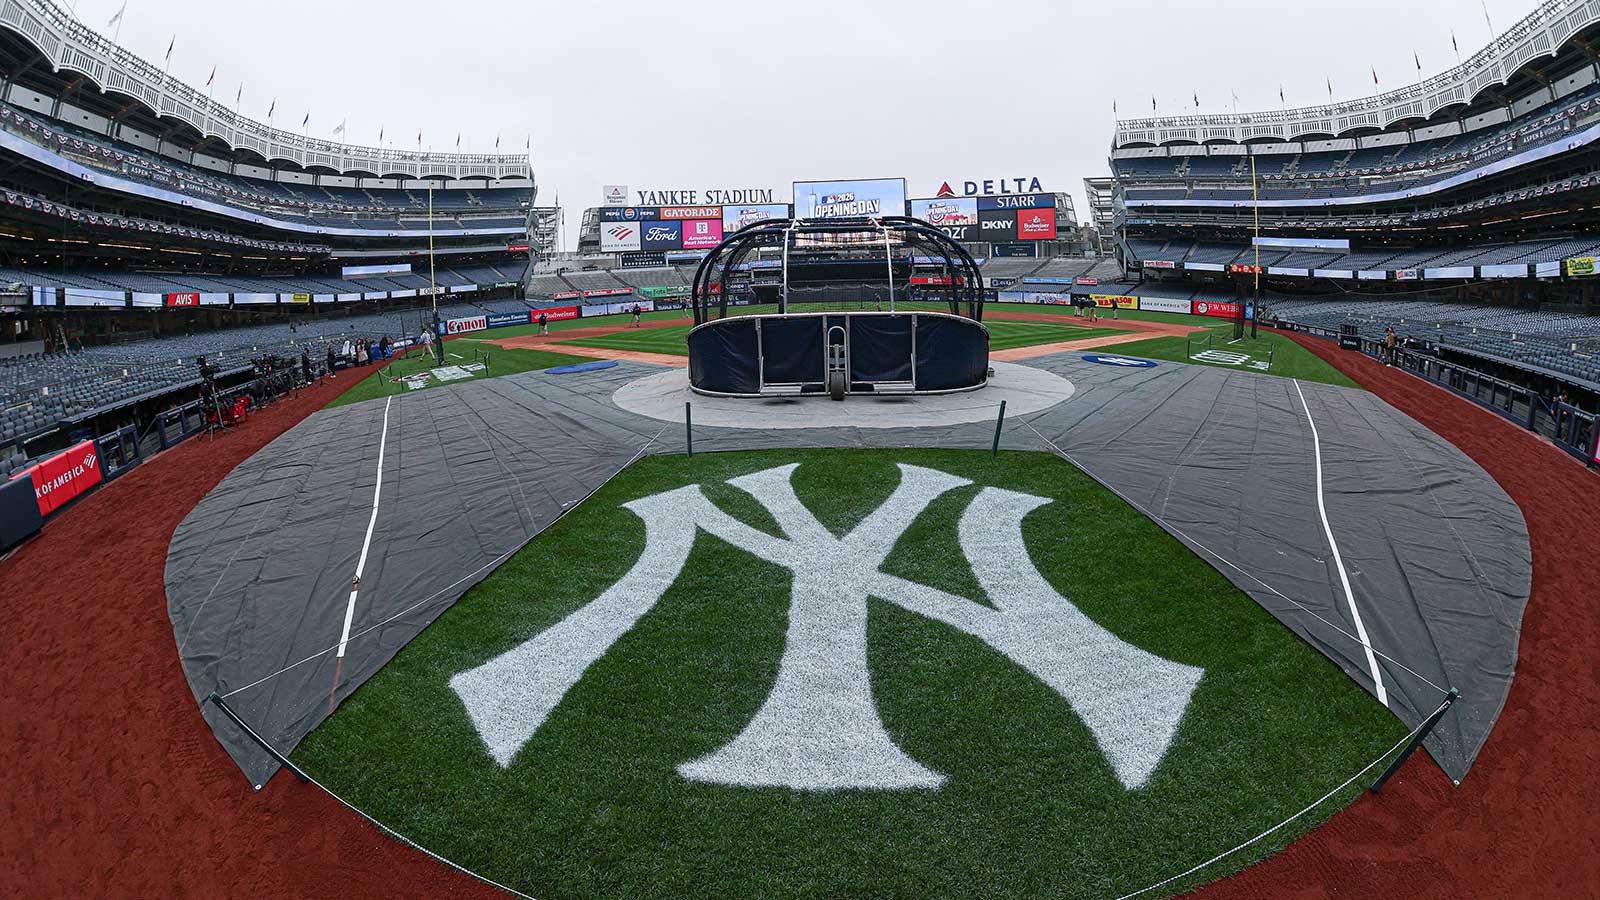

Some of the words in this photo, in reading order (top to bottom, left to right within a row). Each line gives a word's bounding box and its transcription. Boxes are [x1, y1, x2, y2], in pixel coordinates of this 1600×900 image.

[964, 176, 1044, 196] DELTA
[637, 190, 697, 206] YANKEE
[705, 188, 773, 205] STADIUM
[837, 192, 855, 202] 2026
[997, 195, 1036, 207] STARR
[664, 208, 719, 217] GATORADE
[815, 202, 857, 218] OPENING
[858, 199, 880, 215] DAY
[981, 220, 1013, 230] DKNY
[645, 226, 678, 241] Ford
[175, 294, 193, 305] AVIS
[447, 317, 486, 332] Canon
[42, 483, 52, 495] OF
[53, 465, 85, 489] AMERICA
